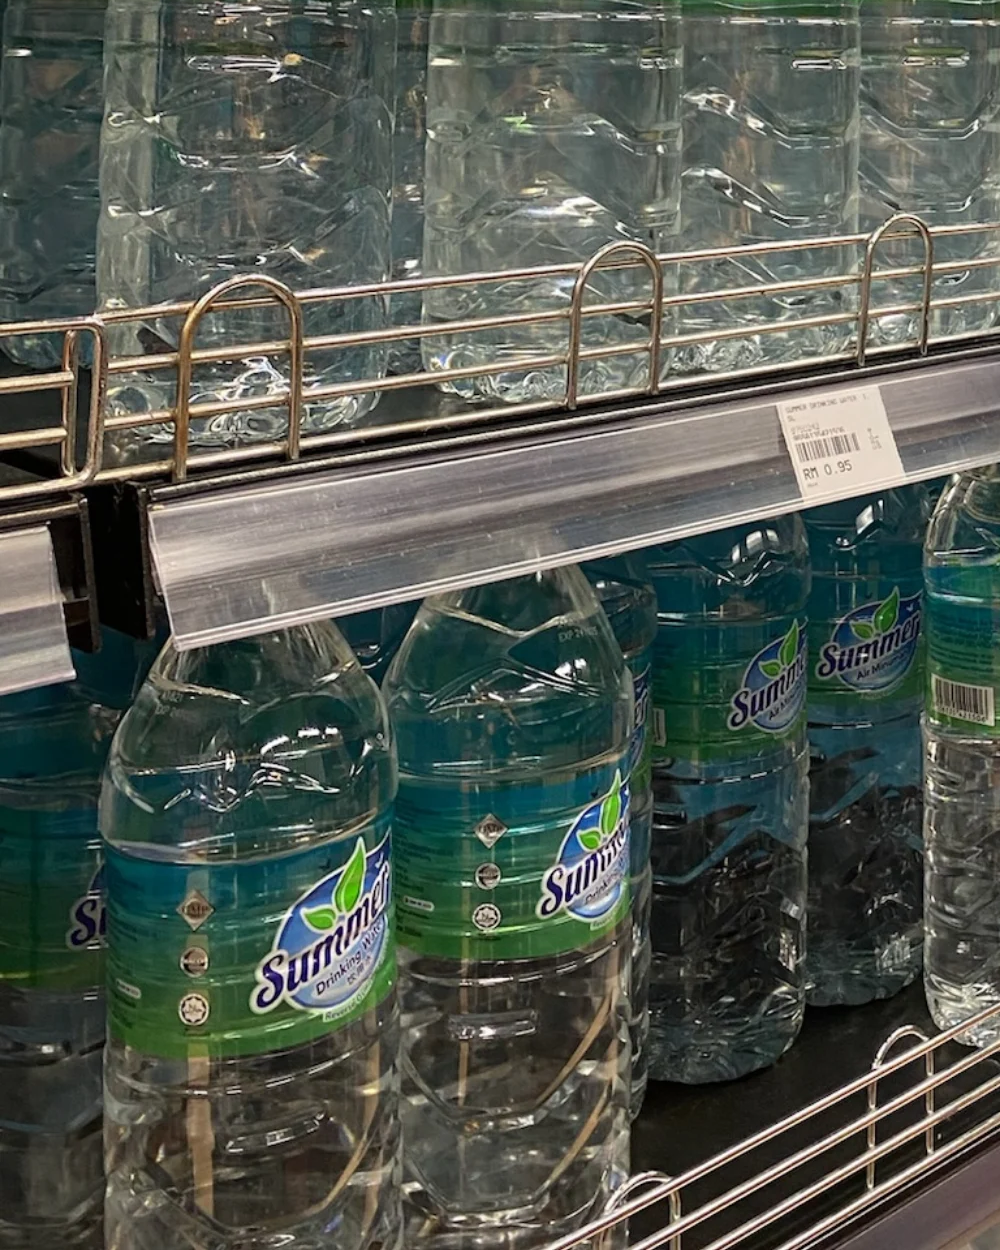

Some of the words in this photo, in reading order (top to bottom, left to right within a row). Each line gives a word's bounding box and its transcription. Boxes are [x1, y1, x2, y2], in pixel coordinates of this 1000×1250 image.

[802, 467, 820, 481] RM
[823, 459, 853, 476] 0.95
[818, 612, 920, 678] Summer
[856, 669, 870, 680] Air
[256, 862, 389, 1009] Summer
[316, 949, 362, 996] Drinking
